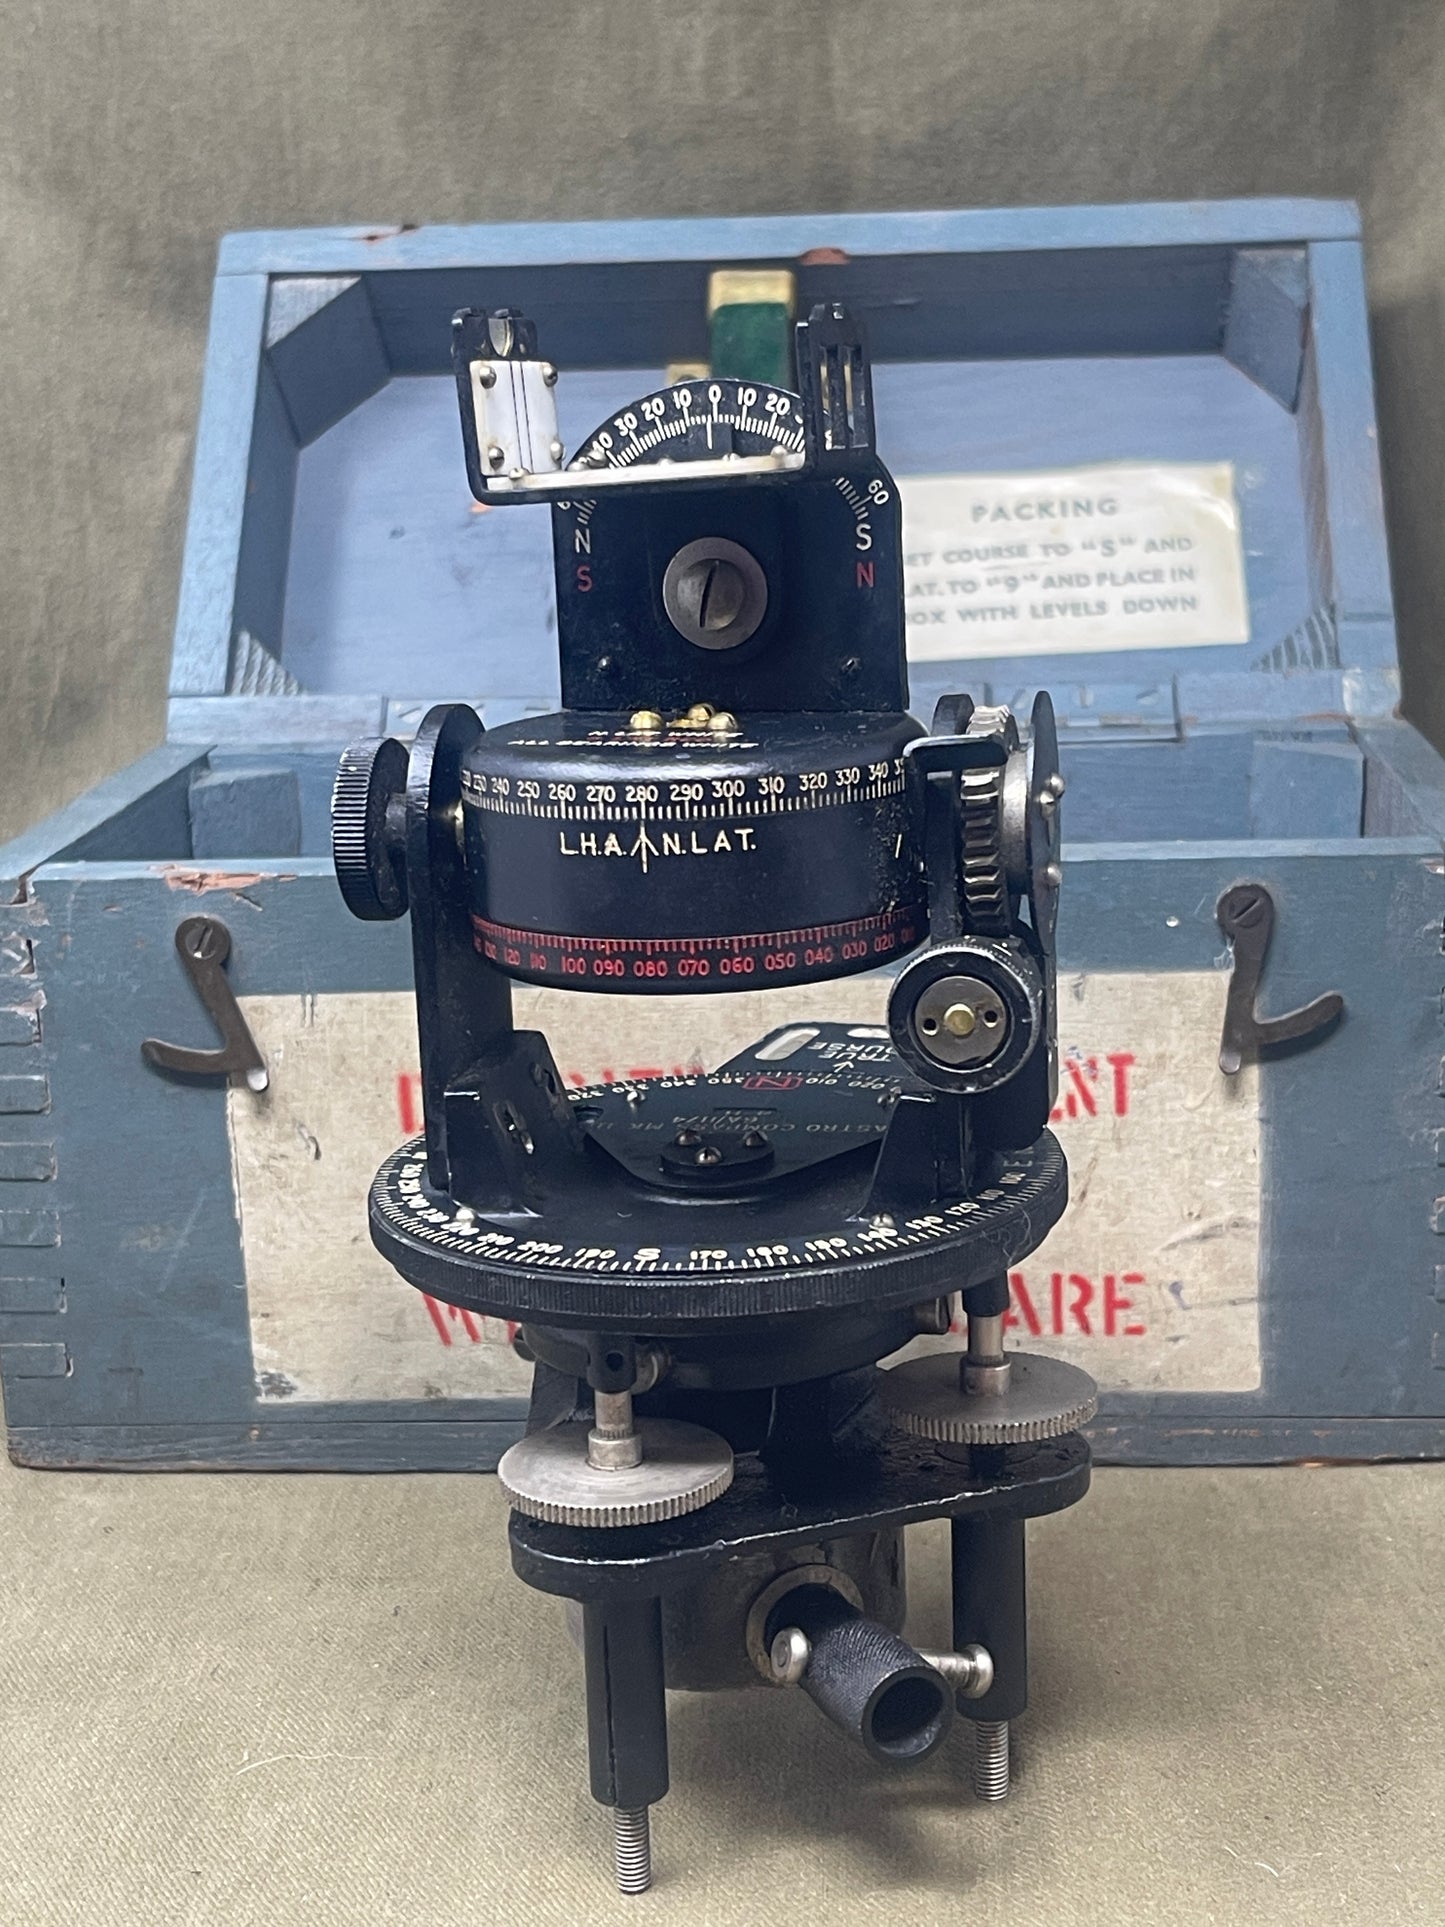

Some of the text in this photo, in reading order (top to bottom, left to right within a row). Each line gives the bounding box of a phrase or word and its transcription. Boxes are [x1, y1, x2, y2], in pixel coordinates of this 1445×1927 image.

[614, 413, 638, 437] 30
[641, 398, 665, 421] 20
[673, 388, 692, 409] 10
[708, 384, 722, 403] 0
[737, 387, 757, 406] 10
[766, 393, 790, 416] 20
[868, 479, 889, 506] 60
[971, 498, 1120, 523] PACKING
[574, 529, 592, 555] N
[855, 523, 873, 550] S
[906, 552, 933, 567] ET
[942, 544, 1029, 564] COURSE
[1039, 542, 1073, 558] TO
[1144, 537, 1193, 554] AND
[577, 565, 593, 593] S
[856, 562, 875, 588] N
[947, 579, 979, 595] TO
[1042, 573, 1091, 589] AND
[1098, 569, 1164, 588] PLACE
[1171, 567, 1195, 582] IN
[907, 596, 1197, 625] OX WITH LEVELS DOWN
[491, 777, 510, 796] 240
[517, 780, 541, 799] 250
[548, 783, 576, 801] 260
[586, 785, 616, 801] 270
[625, 785, 659, 802] 280
[669, 783, 704, 801] 290
[711, 779, 745, 798] 300
[758, 776, 785, 795] 310
[799, 772, 828, 791] 320
[835, 767, 861, 786] 330
[868, 761, 889, 781] 340
[561, 955, 586, 974] 100
[593, 959, 625, 976] 090
[633, 960, 668, 977] 080
[677, 958, 710, 976] 070
[719, 958, 754, 974] 060
[764, 952, 797, 970] 050
[804, 946, 834, 966] 040
[842, 940, 868, 959] 030
[874, 933, 895, 952] 020
[807, 1042, 897, 1054] OURSE
[818, 1051, 891, 1062] TRUE
[944, 1202, 981, 1216] 120
[517, 1241, 564, 1254] 200
[690, 1250, 728, 1260] 170
[949, 1272, 1148, 1337] ARE
